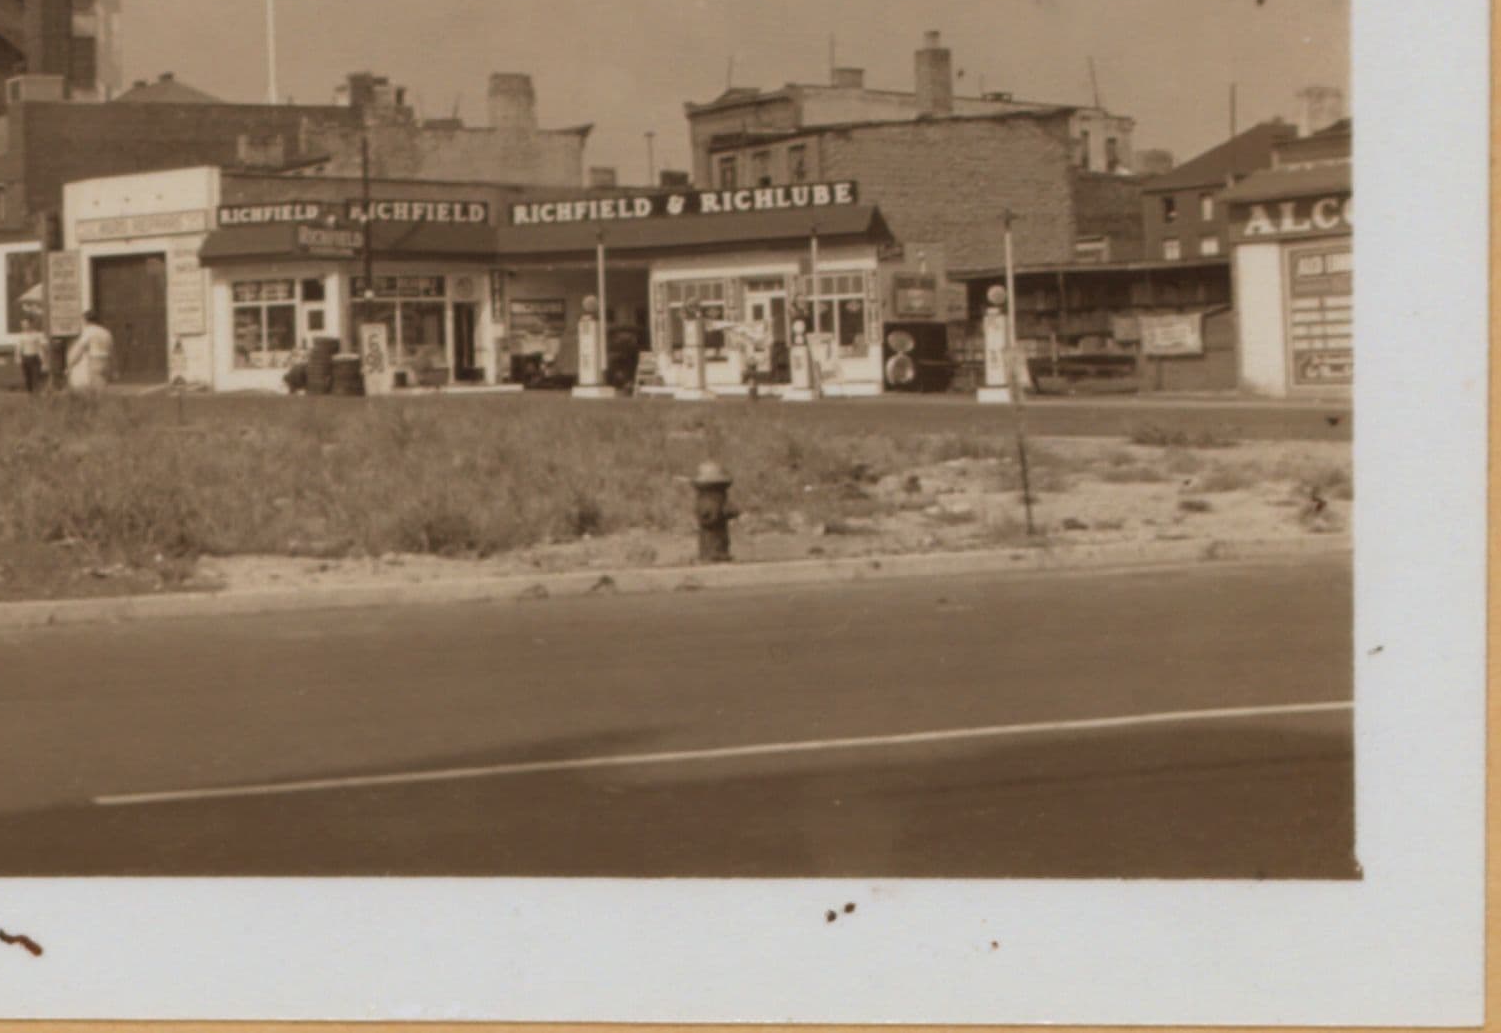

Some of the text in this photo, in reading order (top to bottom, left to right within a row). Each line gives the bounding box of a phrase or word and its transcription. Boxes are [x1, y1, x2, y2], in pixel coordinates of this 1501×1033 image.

[220, 205, 319, 224] RICHFIELD
[513, 182, 853, 224] RICHFIELD & RICHLUBE
